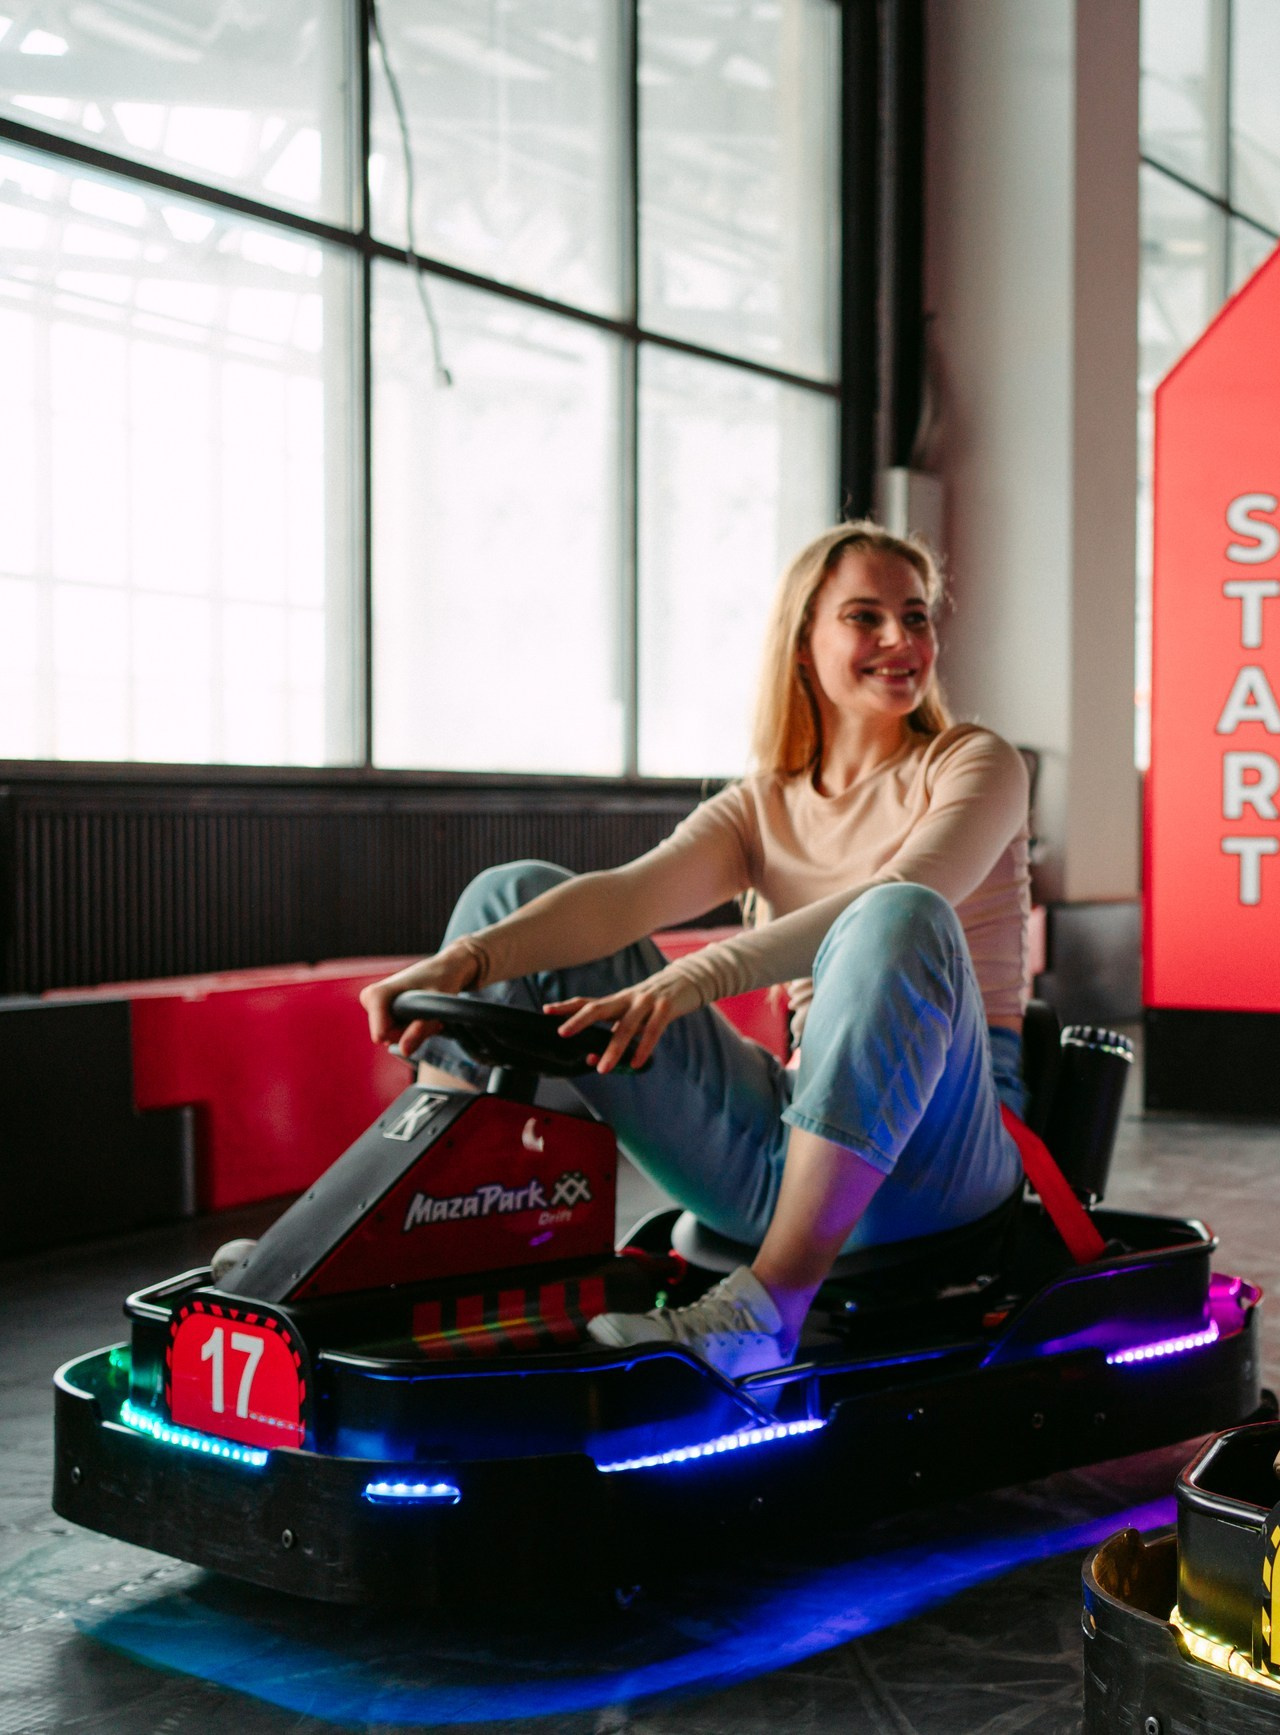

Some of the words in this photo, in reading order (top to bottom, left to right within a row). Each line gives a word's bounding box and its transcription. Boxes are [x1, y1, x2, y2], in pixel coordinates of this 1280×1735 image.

[403, 1179, 548, 1231] MazaPark
[538, 1209, 573, 1227] Drift
[201, 1326, 264, 1419] 17
